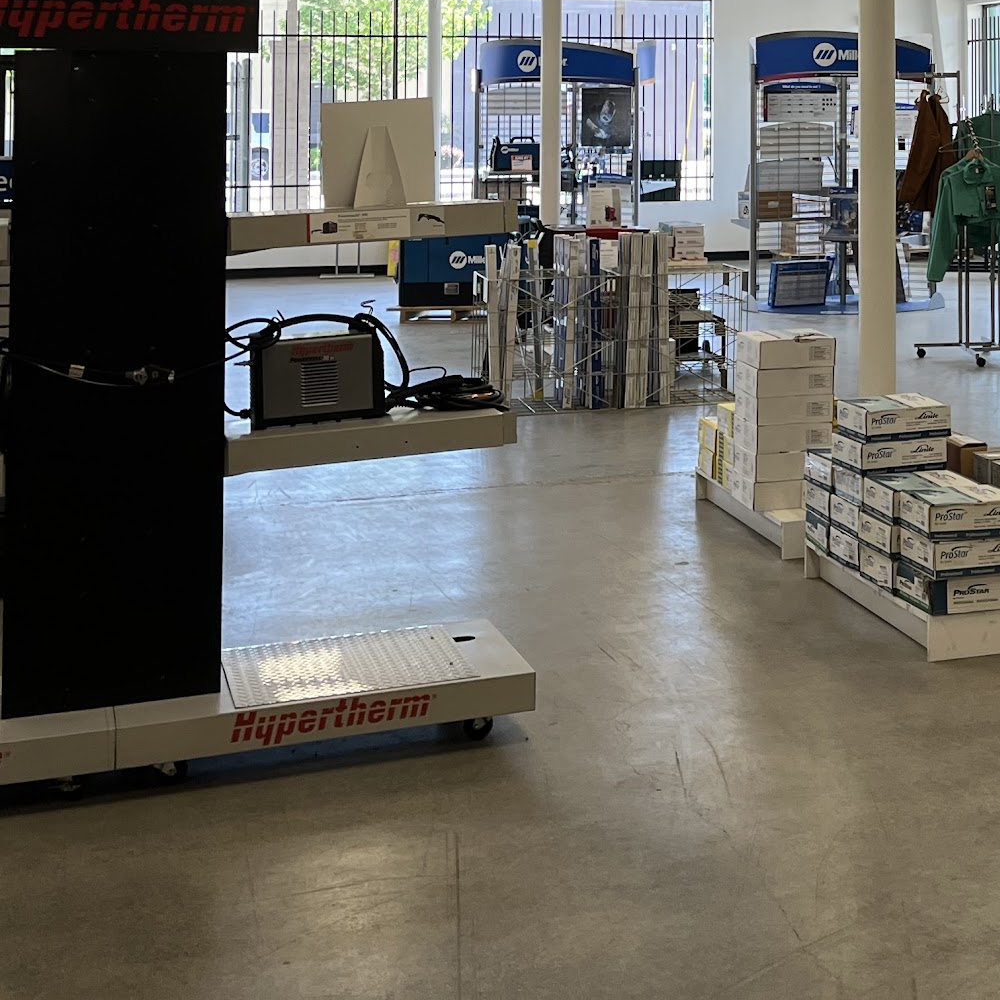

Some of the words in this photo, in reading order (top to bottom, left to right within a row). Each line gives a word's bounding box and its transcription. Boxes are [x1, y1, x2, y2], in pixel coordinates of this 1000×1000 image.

[838, 49, 858, 61] Mill
[871, 415, 897, 426] ProStar
[915, 410, 938, 420] Linde
[910, 444, 935, 453] Linde
[867, 450, 893, 460] ProStar
[935, 511, 964, 522] ProStar
[940, 549, 969, 560] ProStar
[230, 693, 431, 746] Hypertherm
